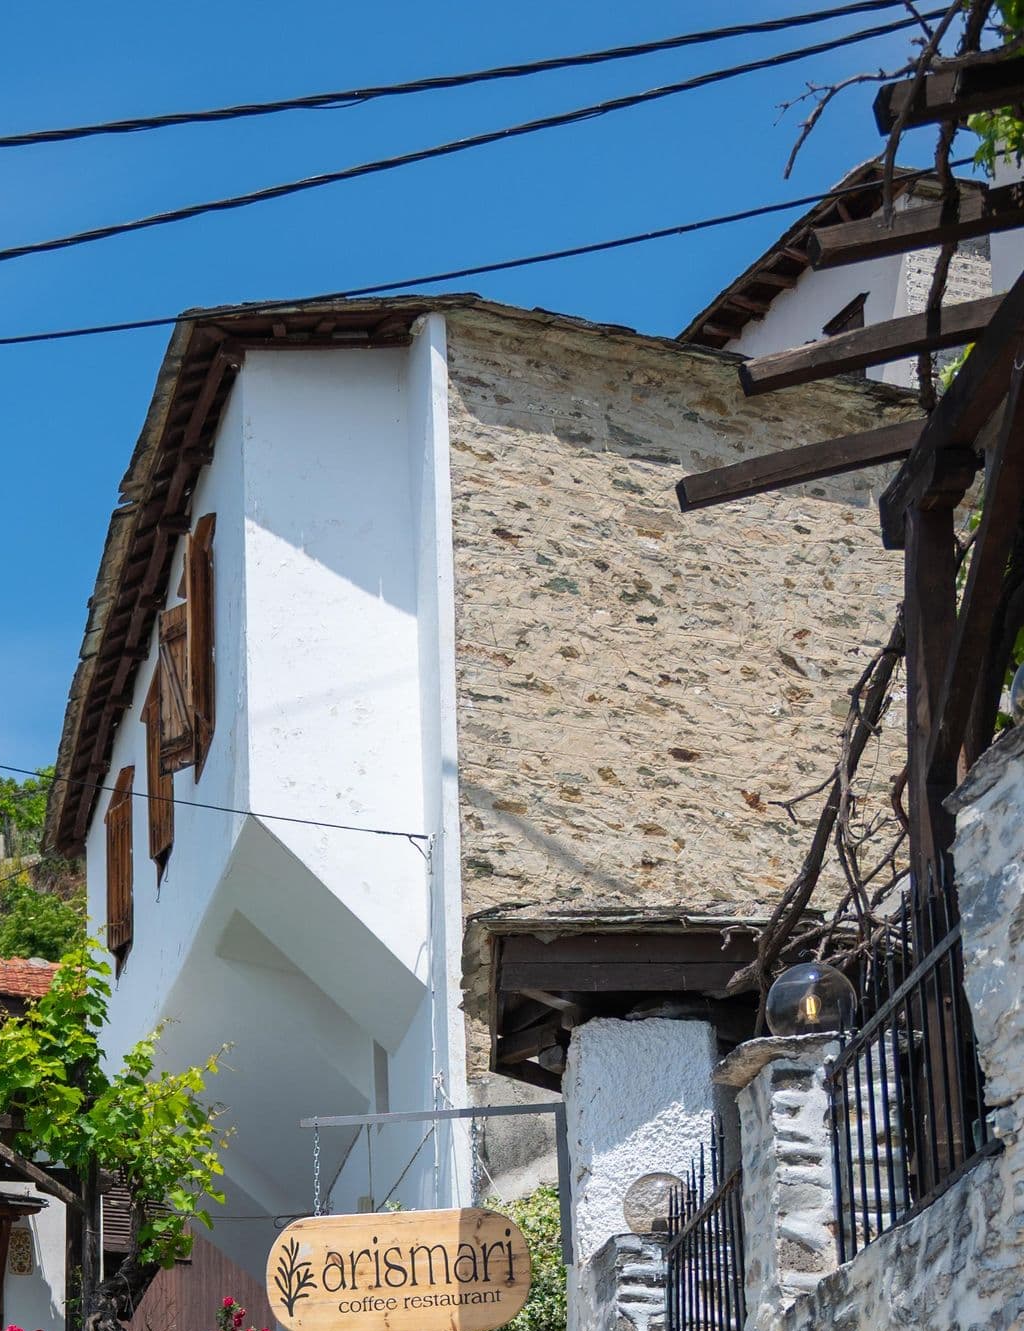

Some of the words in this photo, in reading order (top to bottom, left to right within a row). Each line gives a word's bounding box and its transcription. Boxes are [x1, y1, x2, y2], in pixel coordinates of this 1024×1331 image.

[322, 1228, 515, 1292] arismari
[338, 1296, 398, 1314] coffee
[403, 1289, 502, 1309] restaurant
